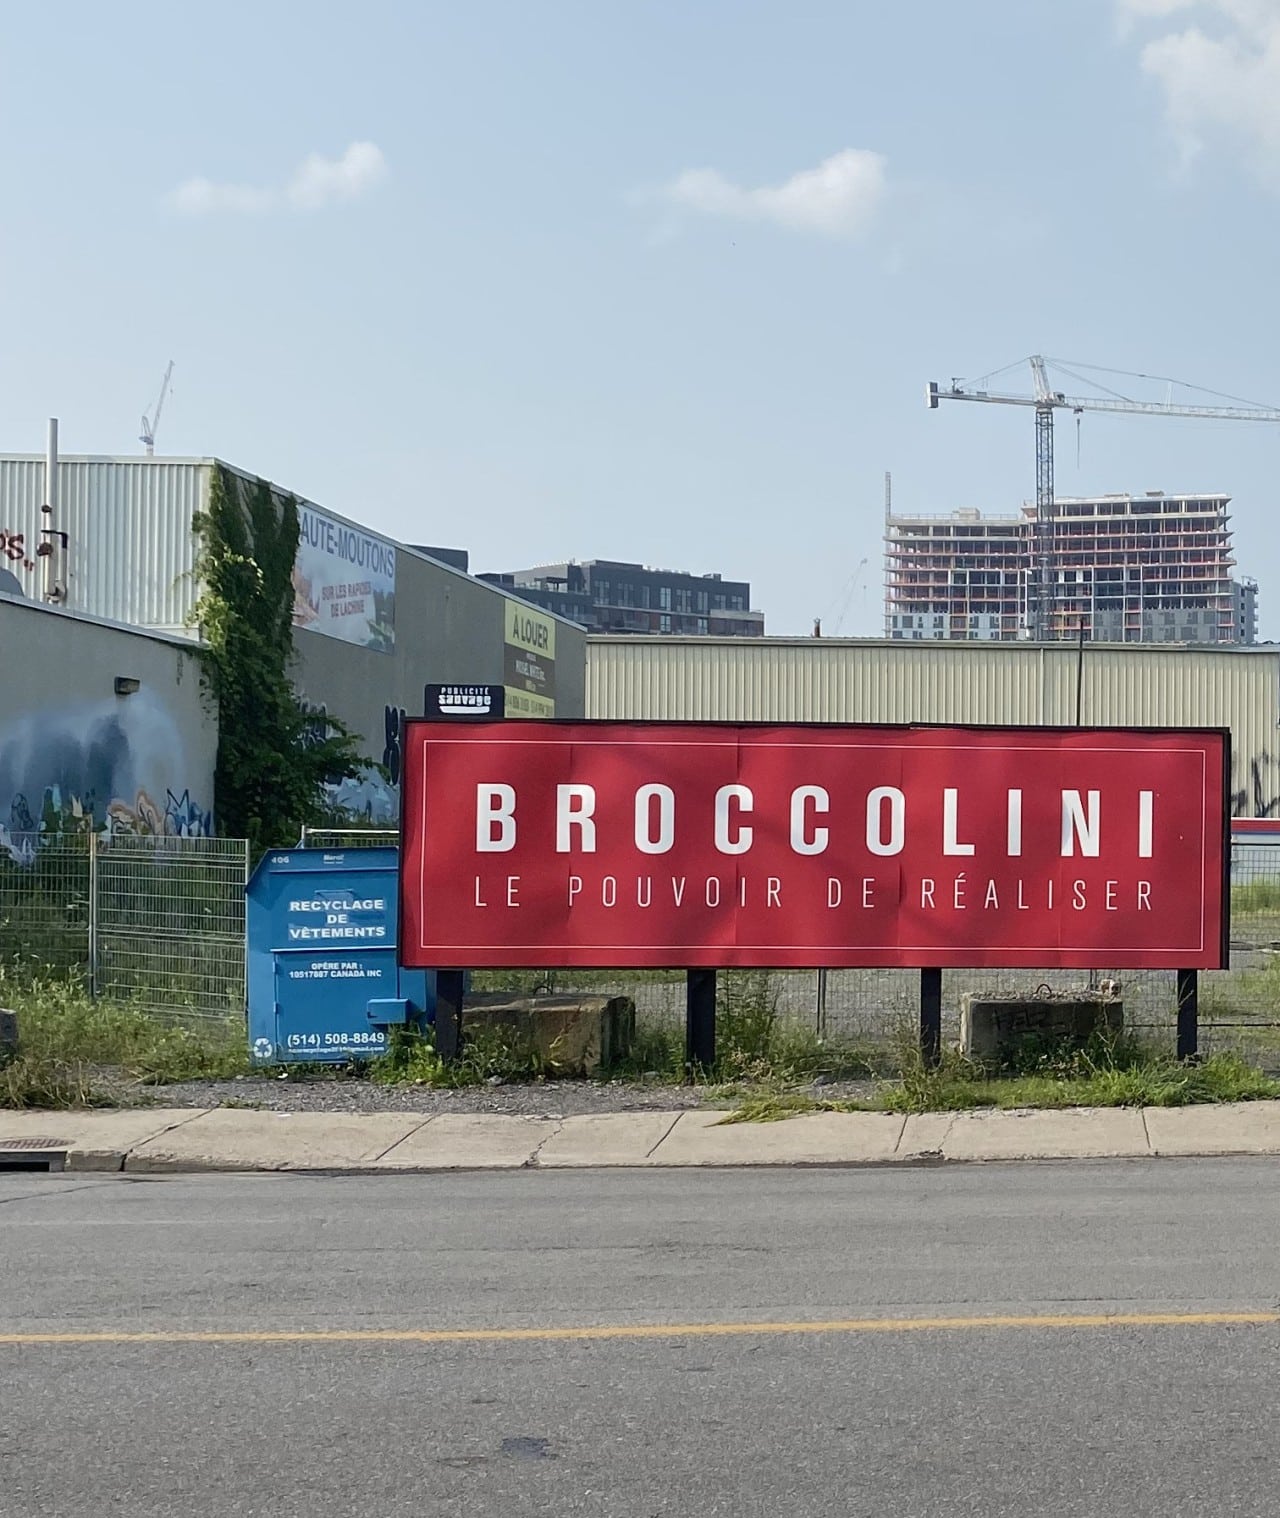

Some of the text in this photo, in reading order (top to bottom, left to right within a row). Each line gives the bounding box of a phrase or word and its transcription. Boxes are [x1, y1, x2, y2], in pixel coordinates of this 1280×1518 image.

[301, 512, 394, 578] AUTE-MOUTONS
[521, 616, 549, 651] LOUER
[441, 687, 489, 695] PUBLICITÉ
[438, 695, 491, 706] sauvage
[476, 783, 1153, 857] BROCCOLINI
[475, 872, 1152, 911] LE POUVOIR DE RÉALISER
[289, 899, 384, 912] RECYCLAGE
[327, 914, 347, 924] DE
[289, 926, 385, 939] VÊTEMENTS
[341, 961, 358, 970] PAR
[330, 970, 365, 978] CANADA
[287, 1032, 385, 1047] (514) 508-8849
